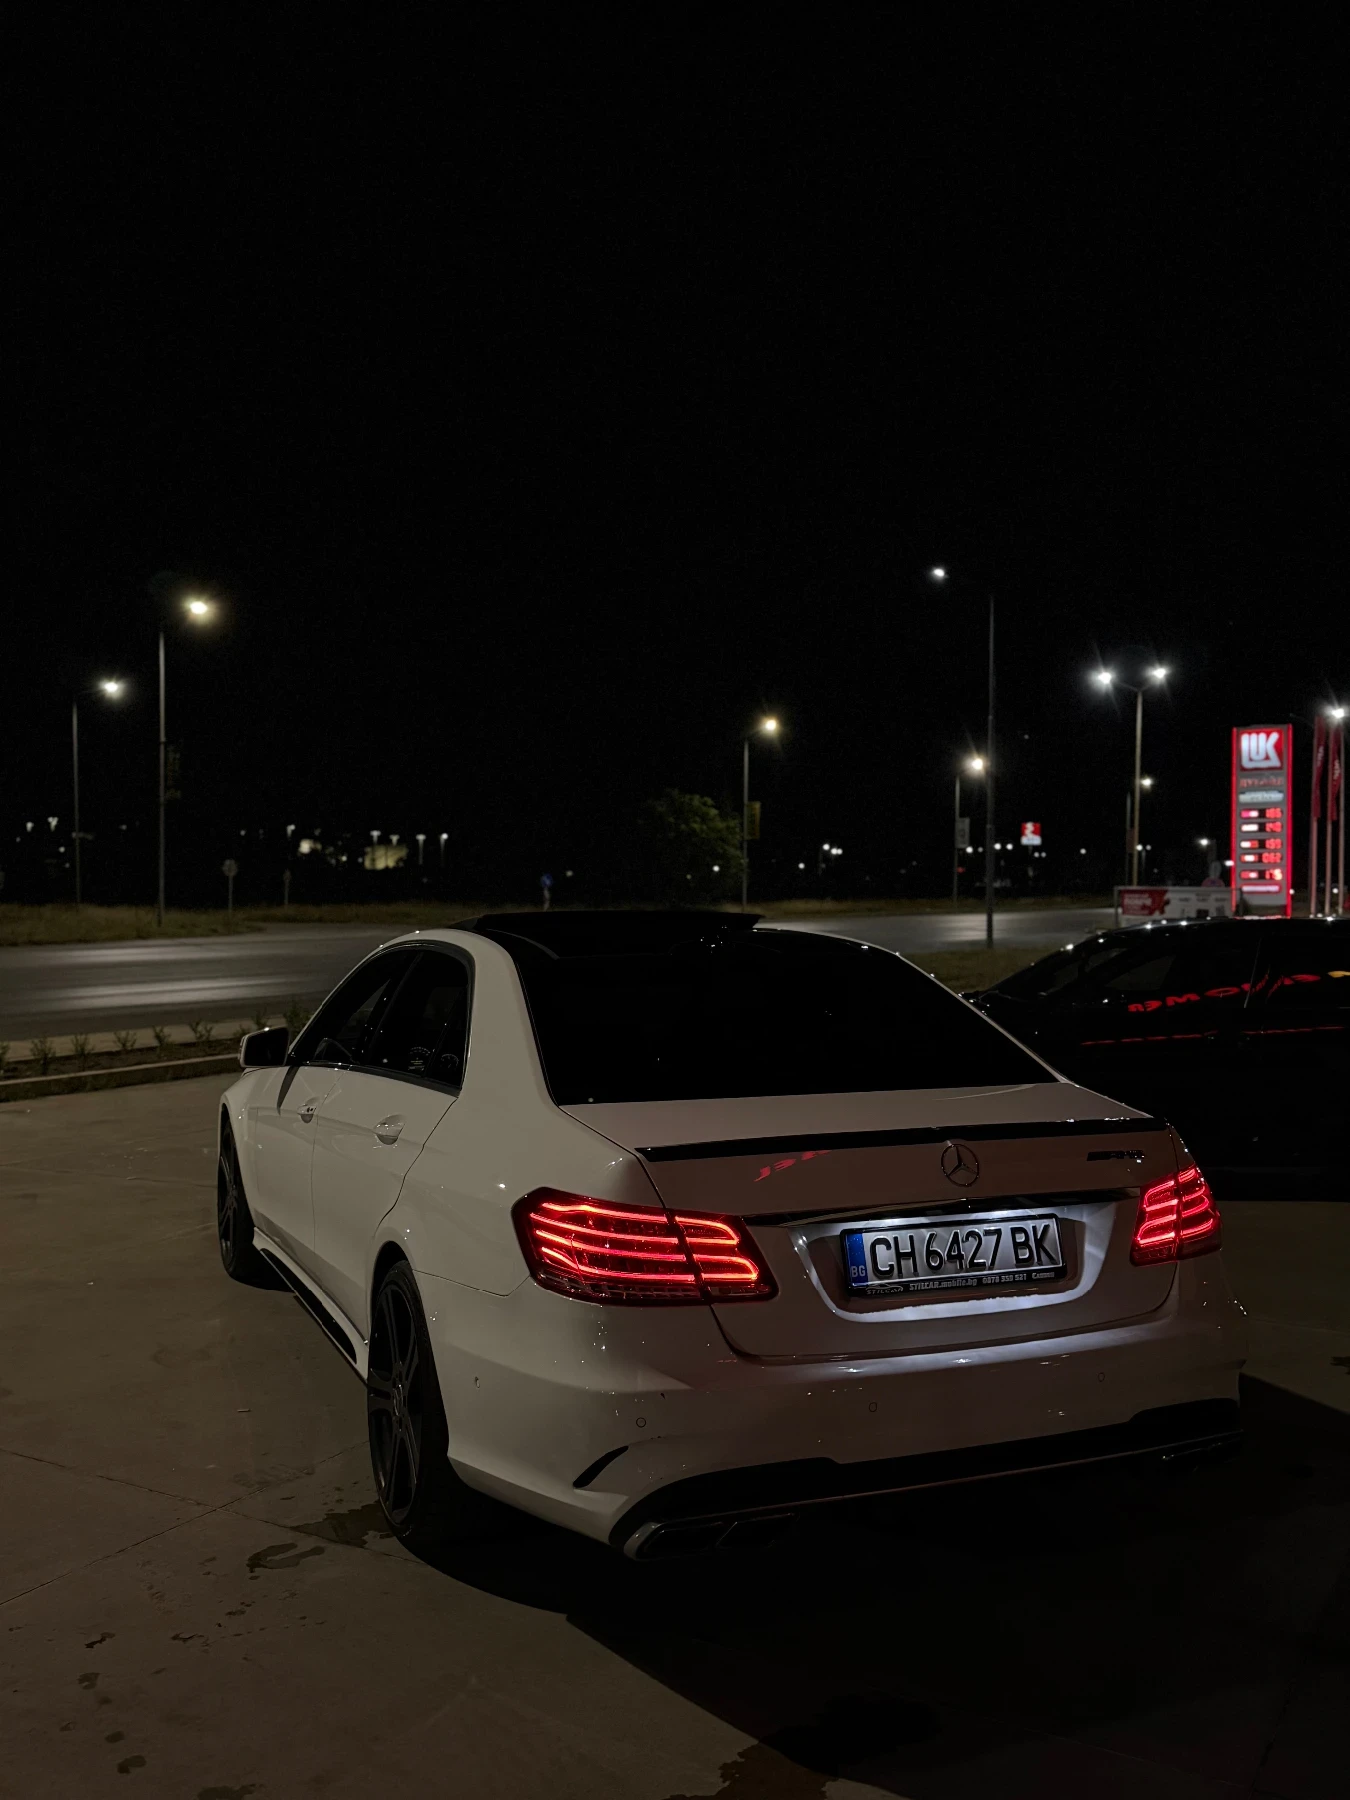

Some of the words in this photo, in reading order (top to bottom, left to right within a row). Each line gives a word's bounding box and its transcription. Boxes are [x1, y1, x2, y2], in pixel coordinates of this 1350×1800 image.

[870, 1232, 919, 1279] CH
[924, 1227, 1002, 1271] 6427
[1009, 1222, 1058, 1267] BK
[850, 1265, 866, 1278] BG
